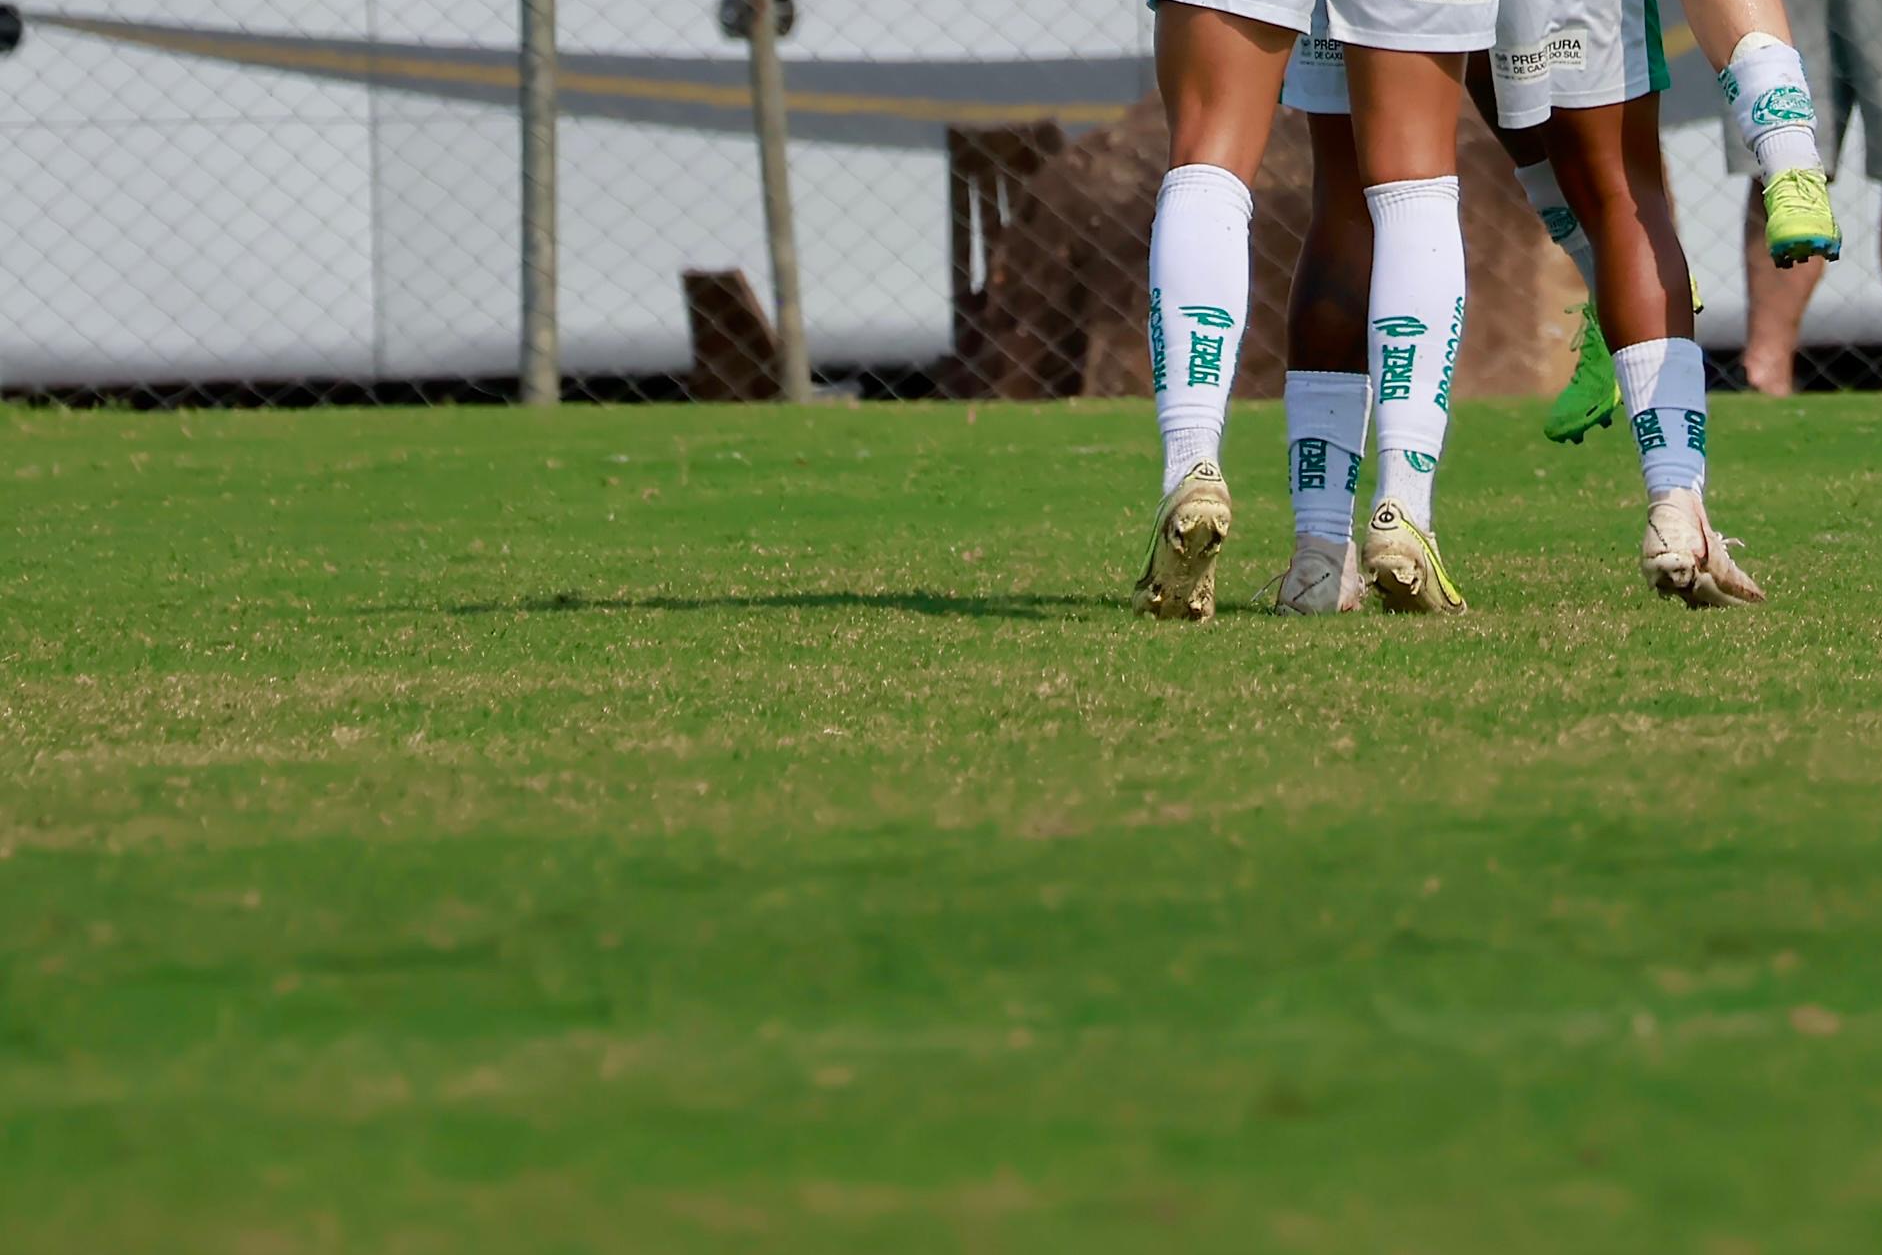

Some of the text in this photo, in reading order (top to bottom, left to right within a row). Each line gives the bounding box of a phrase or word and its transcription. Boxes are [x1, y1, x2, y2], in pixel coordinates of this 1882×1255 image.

[1513, 66, 1525, 75] DE
[1549, 51, 1562, 60] DO
[1564, 50, 1582, 60] SUL
